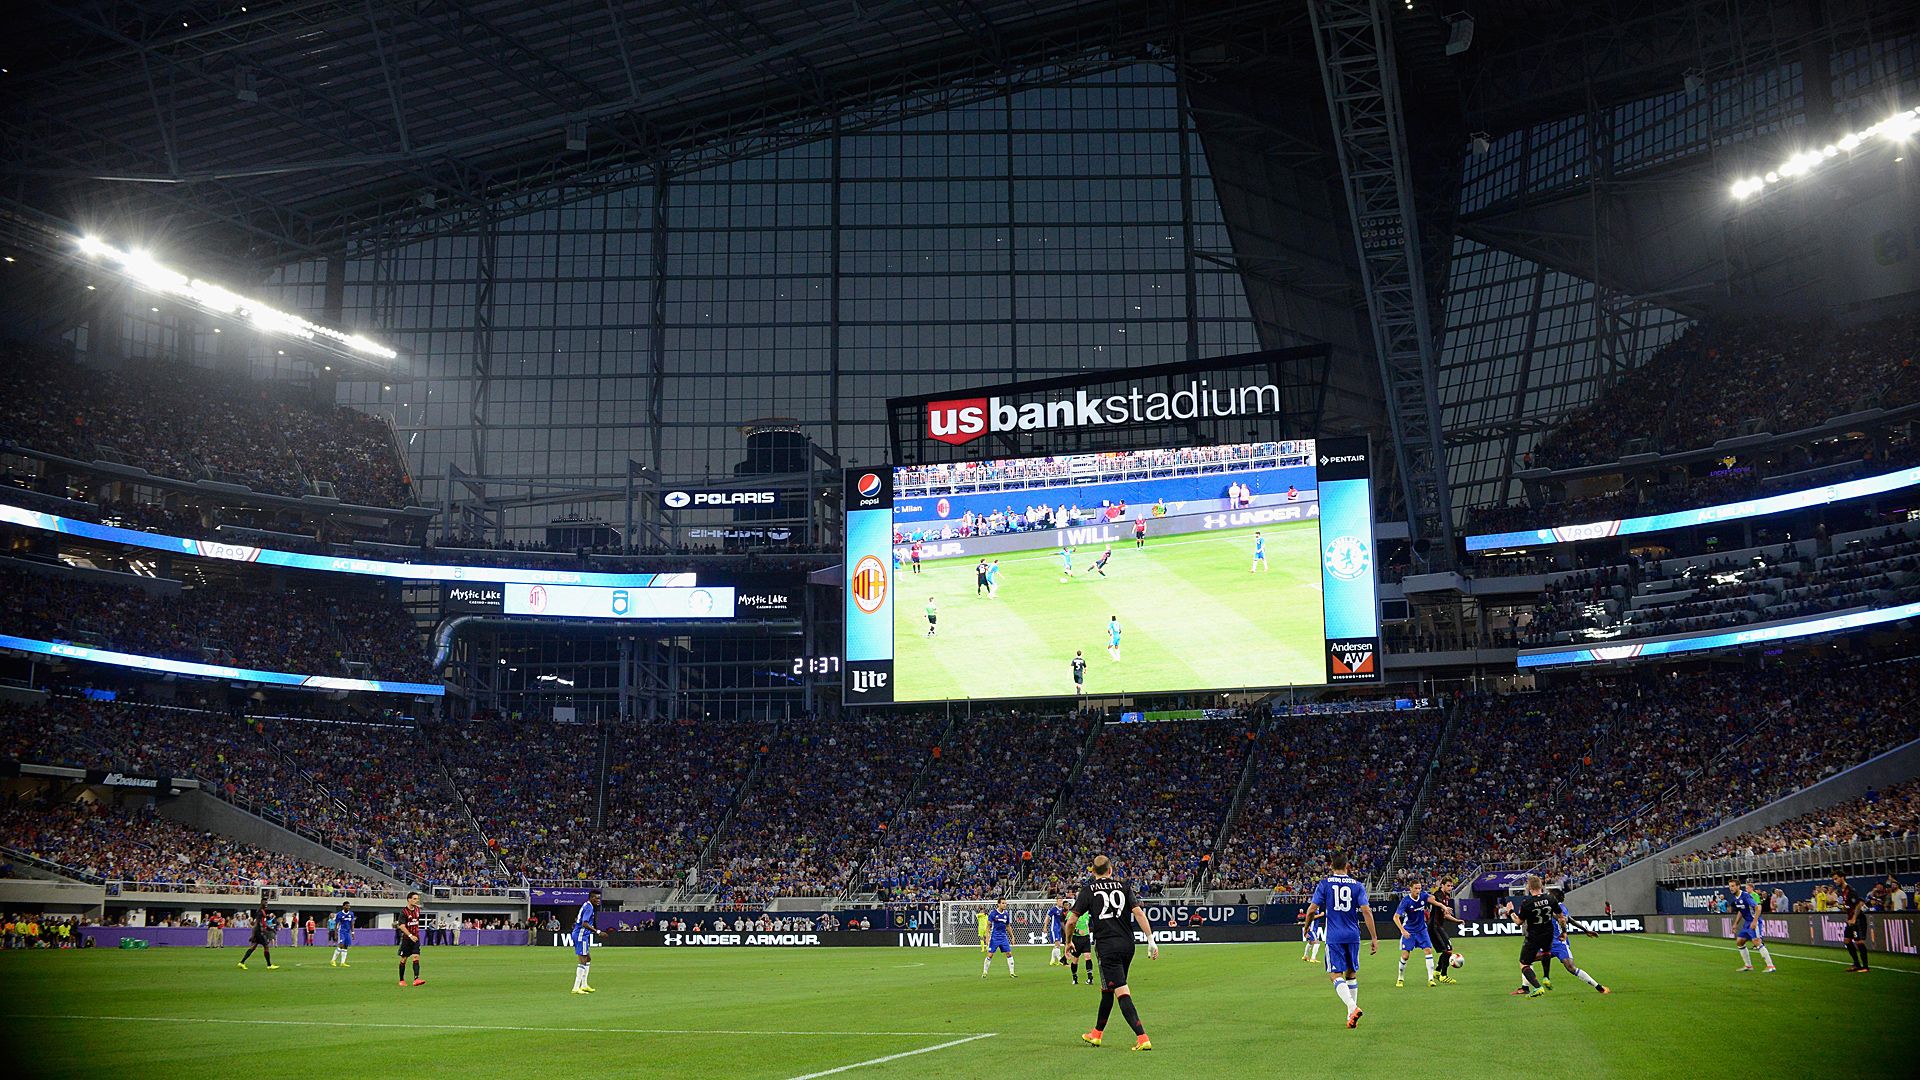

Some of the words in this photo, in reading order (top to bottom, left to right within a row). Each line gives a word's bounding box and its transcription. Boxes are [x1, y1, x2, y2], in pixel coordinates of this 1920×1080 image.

[1330, 455, 1365, 464] PENTAIR
[694, 492, 775, 504] POLARIS
[860, 498, 880, 506] pepsi
[901, 505, 923, 513] Milan
[1232, 507, 1300, 525] UNDER
[1058, 532, 1064, 546] I
[1331, 642, 1373, 652] Andersen
[793, 657, 839, 675] 21:37
[852, 670, 888, 693] Lite
[1090, 881, 1123, 891] PALETTA
[1093, 889, 1126, 920] 29
[1331, 884, 1353, 912] 19
[1532, 906, 1552, 925] 33
[1484, 923, 1522, 935] UND
[554, 933, 558, 947] I
[561, 933, 602, 947] WL.
[685, 934, 741, 945] UNDER
[744, 934, 821, 945] ARMOUR.
[900, 932, 904, 947] I
